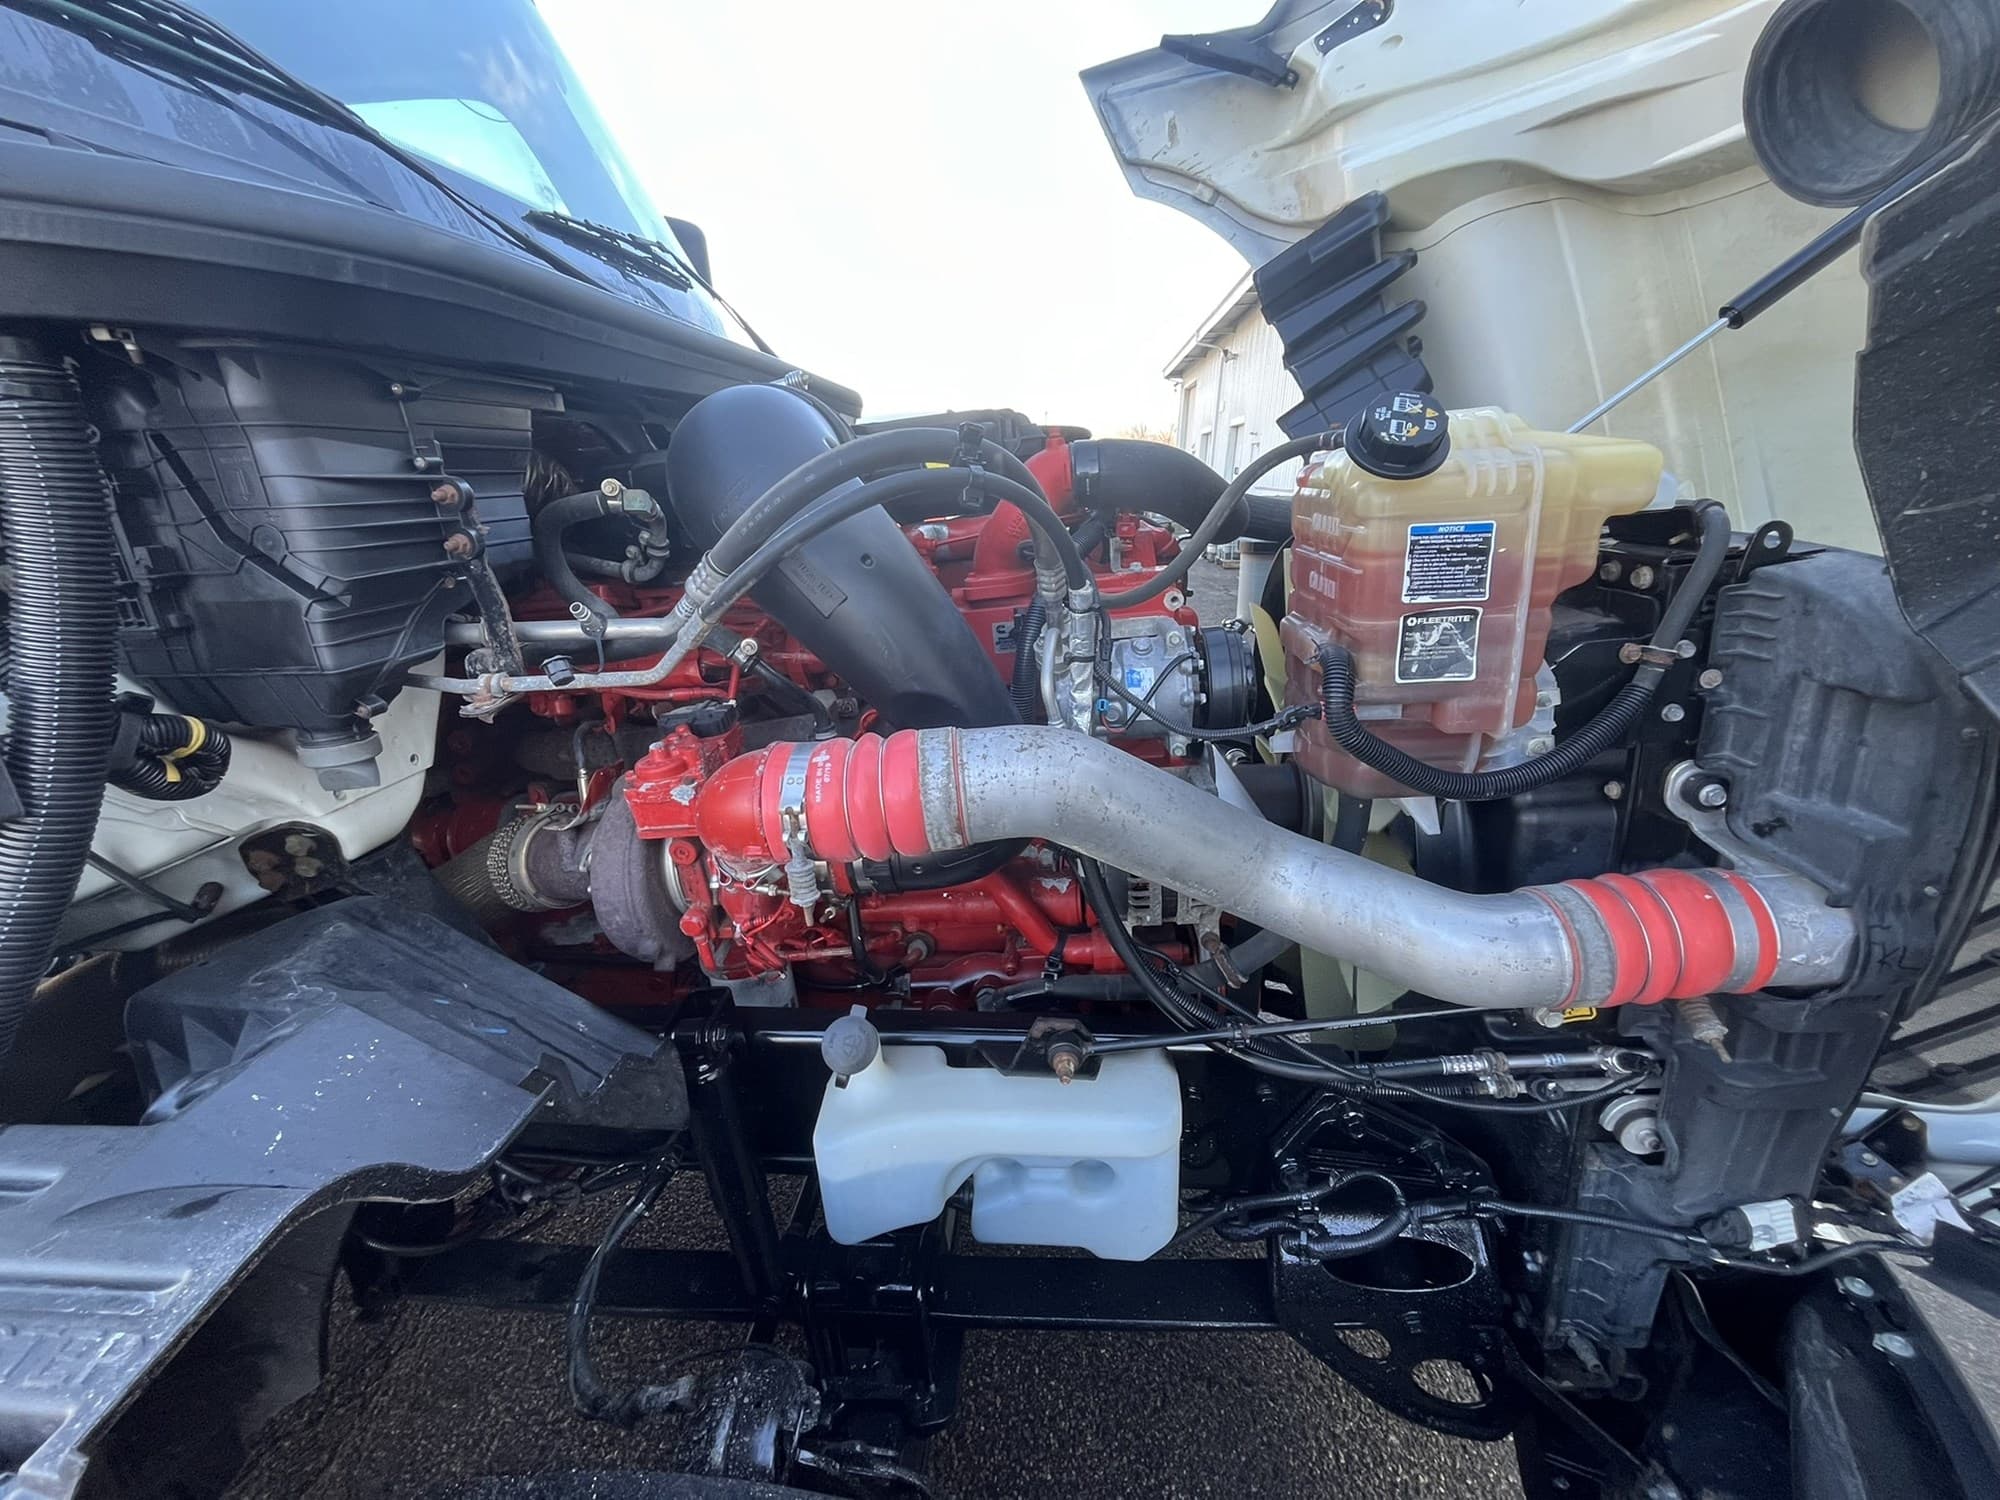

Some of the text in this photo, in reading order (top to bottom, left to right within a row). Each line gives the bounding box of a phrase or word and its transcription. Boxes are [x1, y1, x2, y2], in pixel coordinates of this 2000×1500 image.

[1438, 525, 1466, 534] NOTICE
[1417, 615, 1472, 625] FLEETRITE
[815, 777, 823, 803] MADE
